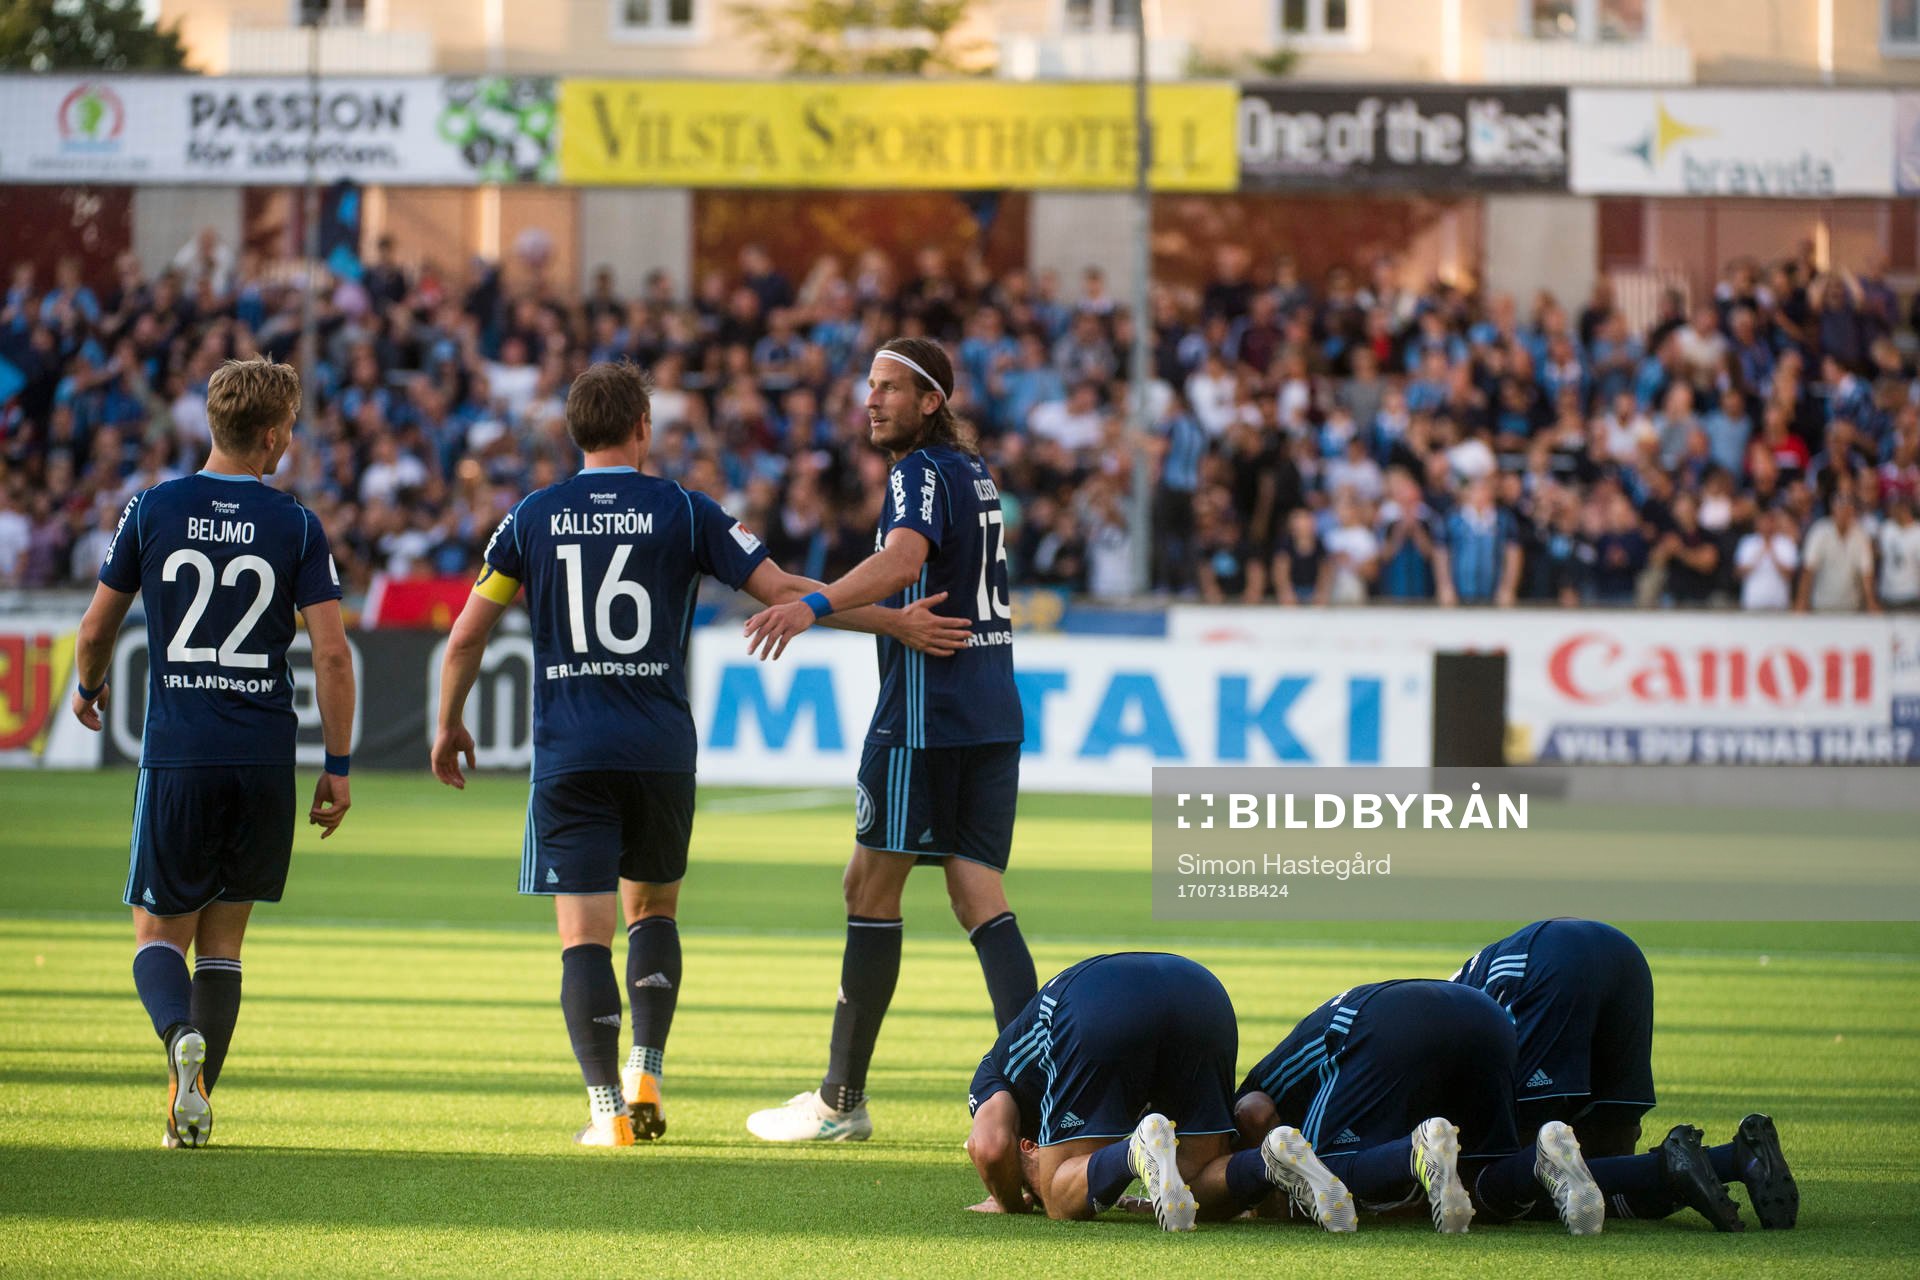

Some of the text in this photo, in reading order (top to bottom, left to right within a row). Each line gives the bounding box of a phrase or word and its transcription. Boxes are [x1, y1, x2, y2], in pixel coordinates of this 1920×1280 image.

[1386, 98, 1464, 164] the
[187, 517, 256, 545] BEIJMO
[550, 508, 654, 536] KÄLLSTRÖM
[919, 466, 938, 526] stadium
[162, 548, 277, 669] 22
[556, 543, 653, 655] 16
[1547, 630, 1875, 708] Canon
[707, 663, 1383, 765] MTAKI
